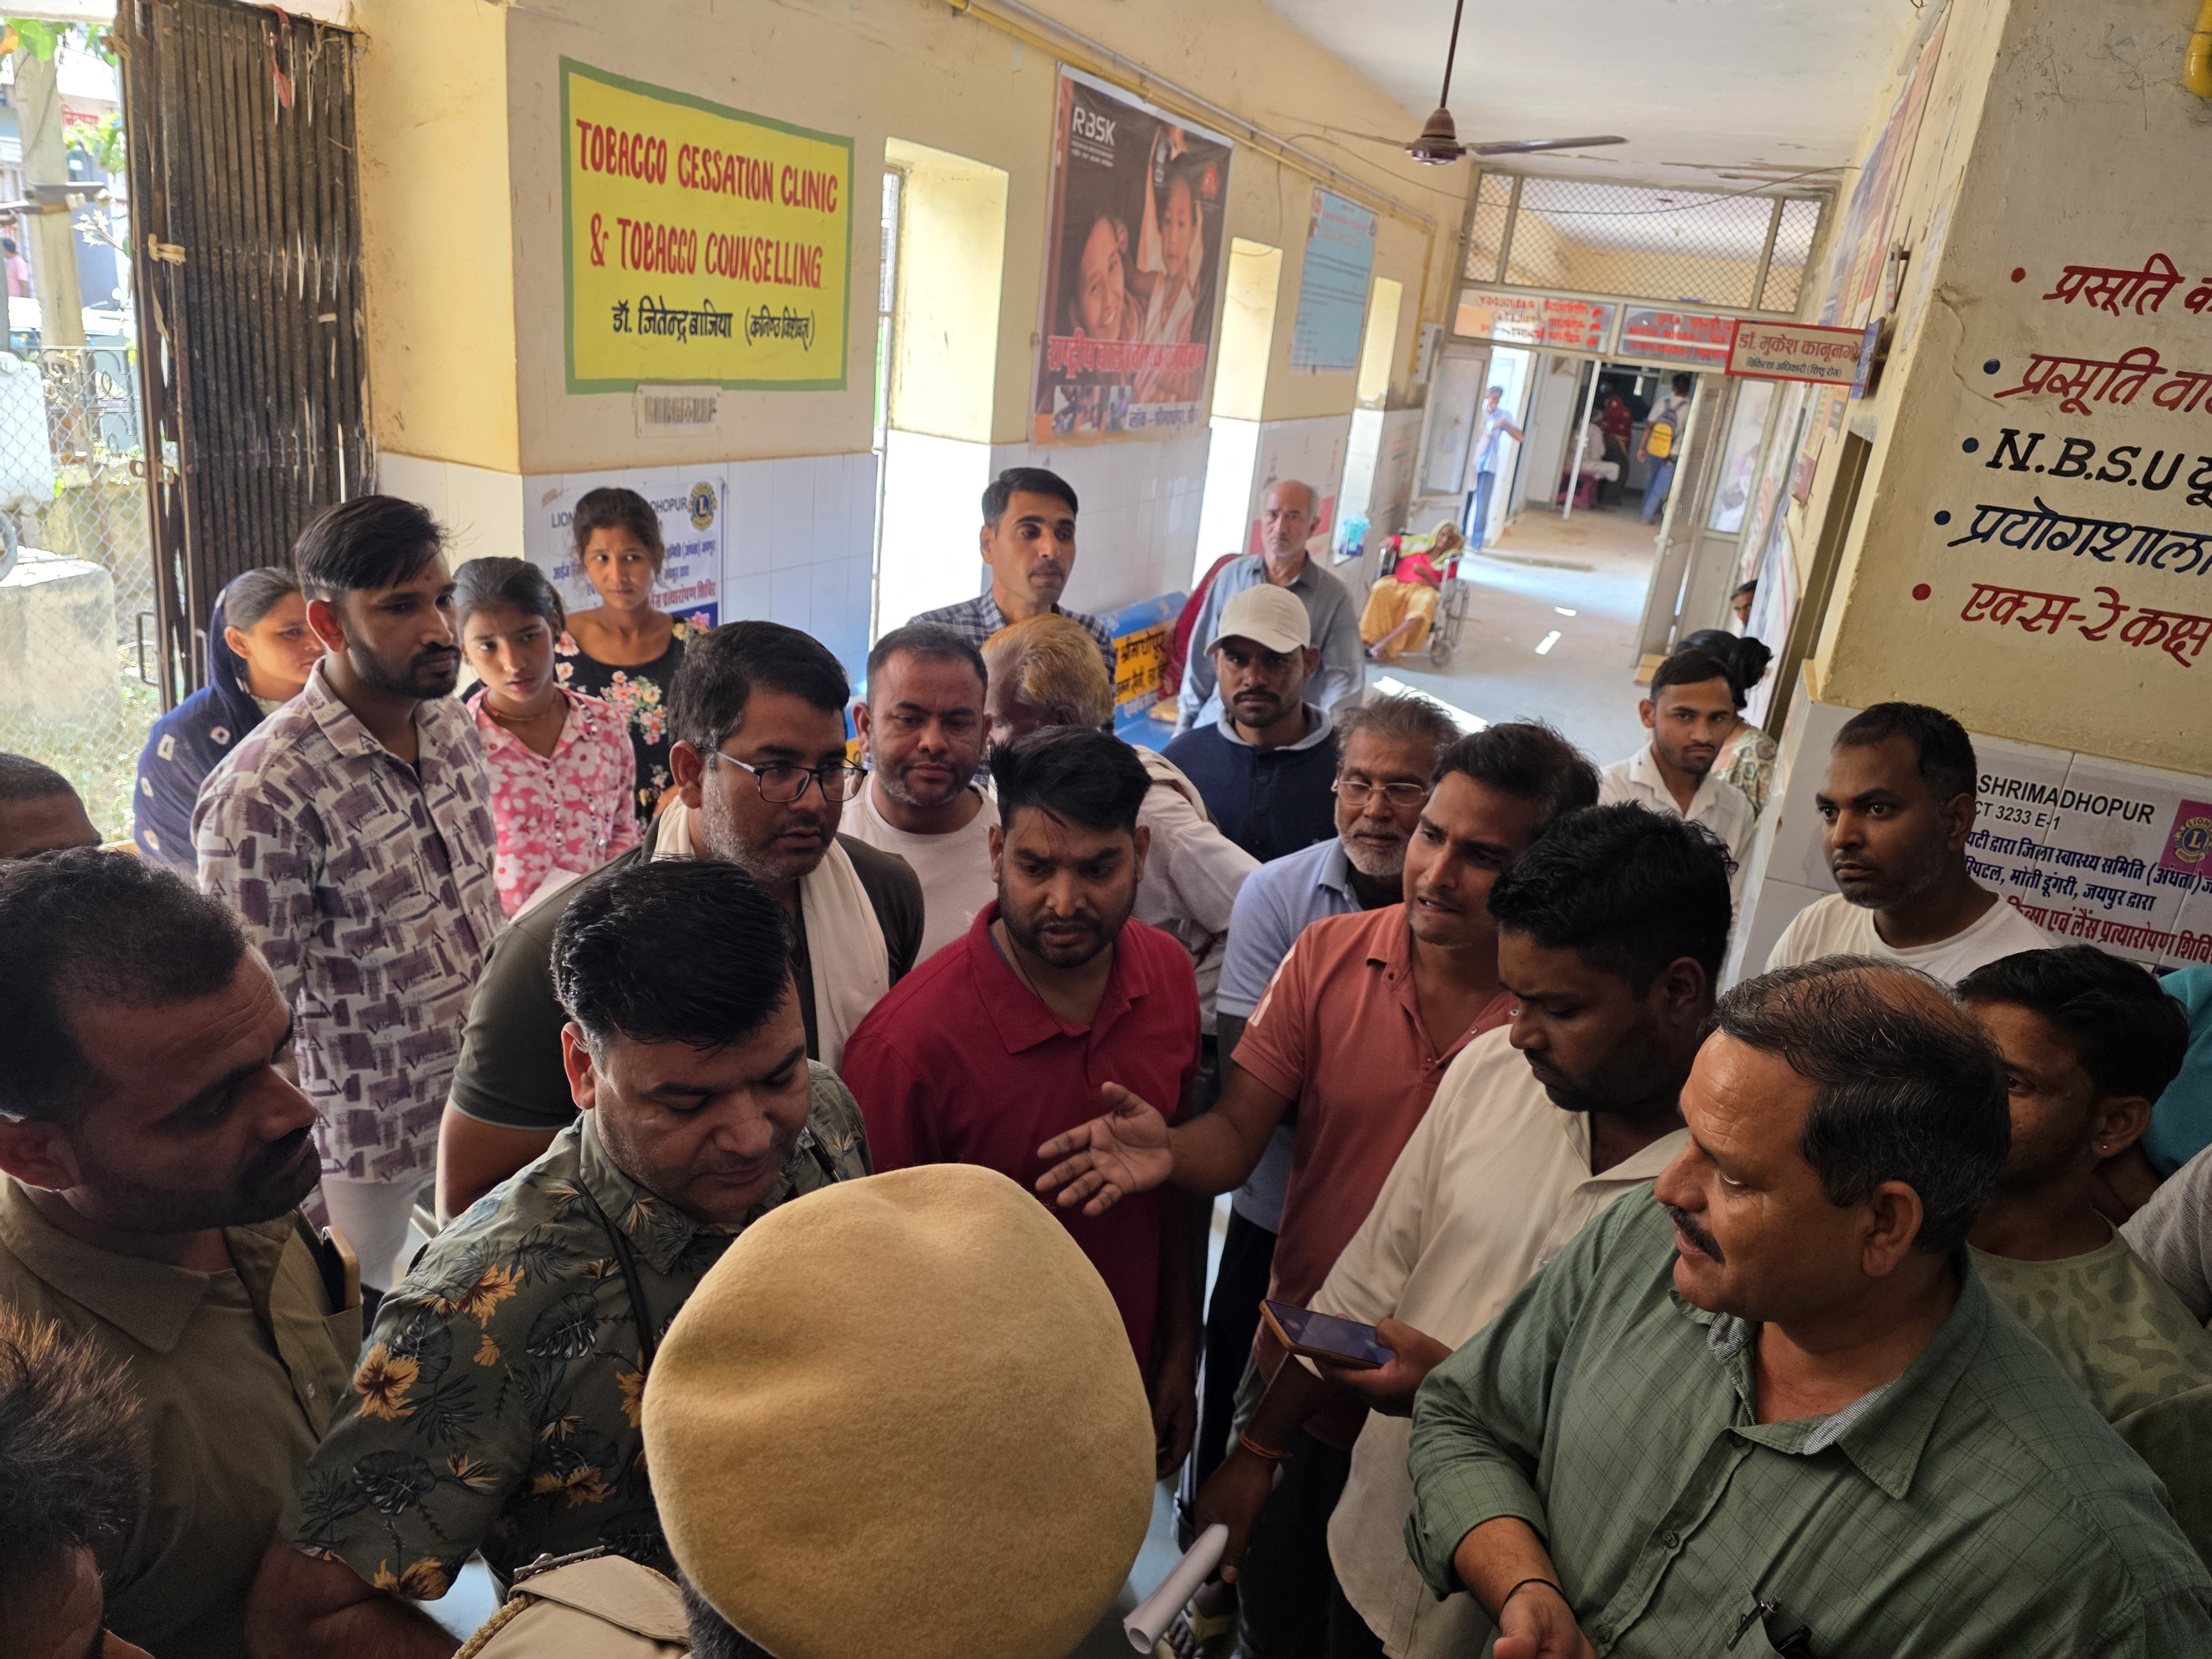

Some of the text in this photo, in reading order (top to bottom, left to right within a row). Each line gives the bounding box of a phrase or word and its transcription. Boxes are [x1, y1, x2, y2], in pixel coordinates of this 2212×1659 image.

[1072, 106, 1117, 147] RBSK
[577, 118, 838, 213] TOBACCO CESSATION CLINIC
[591, 212, 823, 289] & TOBACCO COUNSELLING
[2042, 253, 2185, 316] प्रसूति
[612, 299, 632, 333] डॉ.
[639, 295, 688, 344] जितेन्द्र
[1759, 334, 1798, 356] मुकेश
[1994, 347, 2212, 416] प्रसूति वा
[1947, 496, 2212, 576] प्रयोगशाला
[1961, 582, 2212, 668] एक्स-रे कक्ष
[1977, 774, 2156, 825] SHRIMADHOPUR
[1995, 806, 2032, 825] 3233
[2035, 812, 2060, 830] E-1
[1965, 830, 1990, 849] यटी
[1989, 836, 2018, 855] द्वारा
[2017, 837, 2056, 863] जिला
[2055, 847, 2102, 871] स्वास्थ्य
[2101, 855, 2147, 880] समिति
[2010, 866, 2043, 889] मोती
[2082, 883, 2128, 910] जयपुर
[2126, 891, 2158, 911] द्वारा
[2047, 906, 2077, 935] एवं
[2096, 921, 2178, 956] प्रत्यारोपण
[2173, 929, 2212, 964] शिवि
